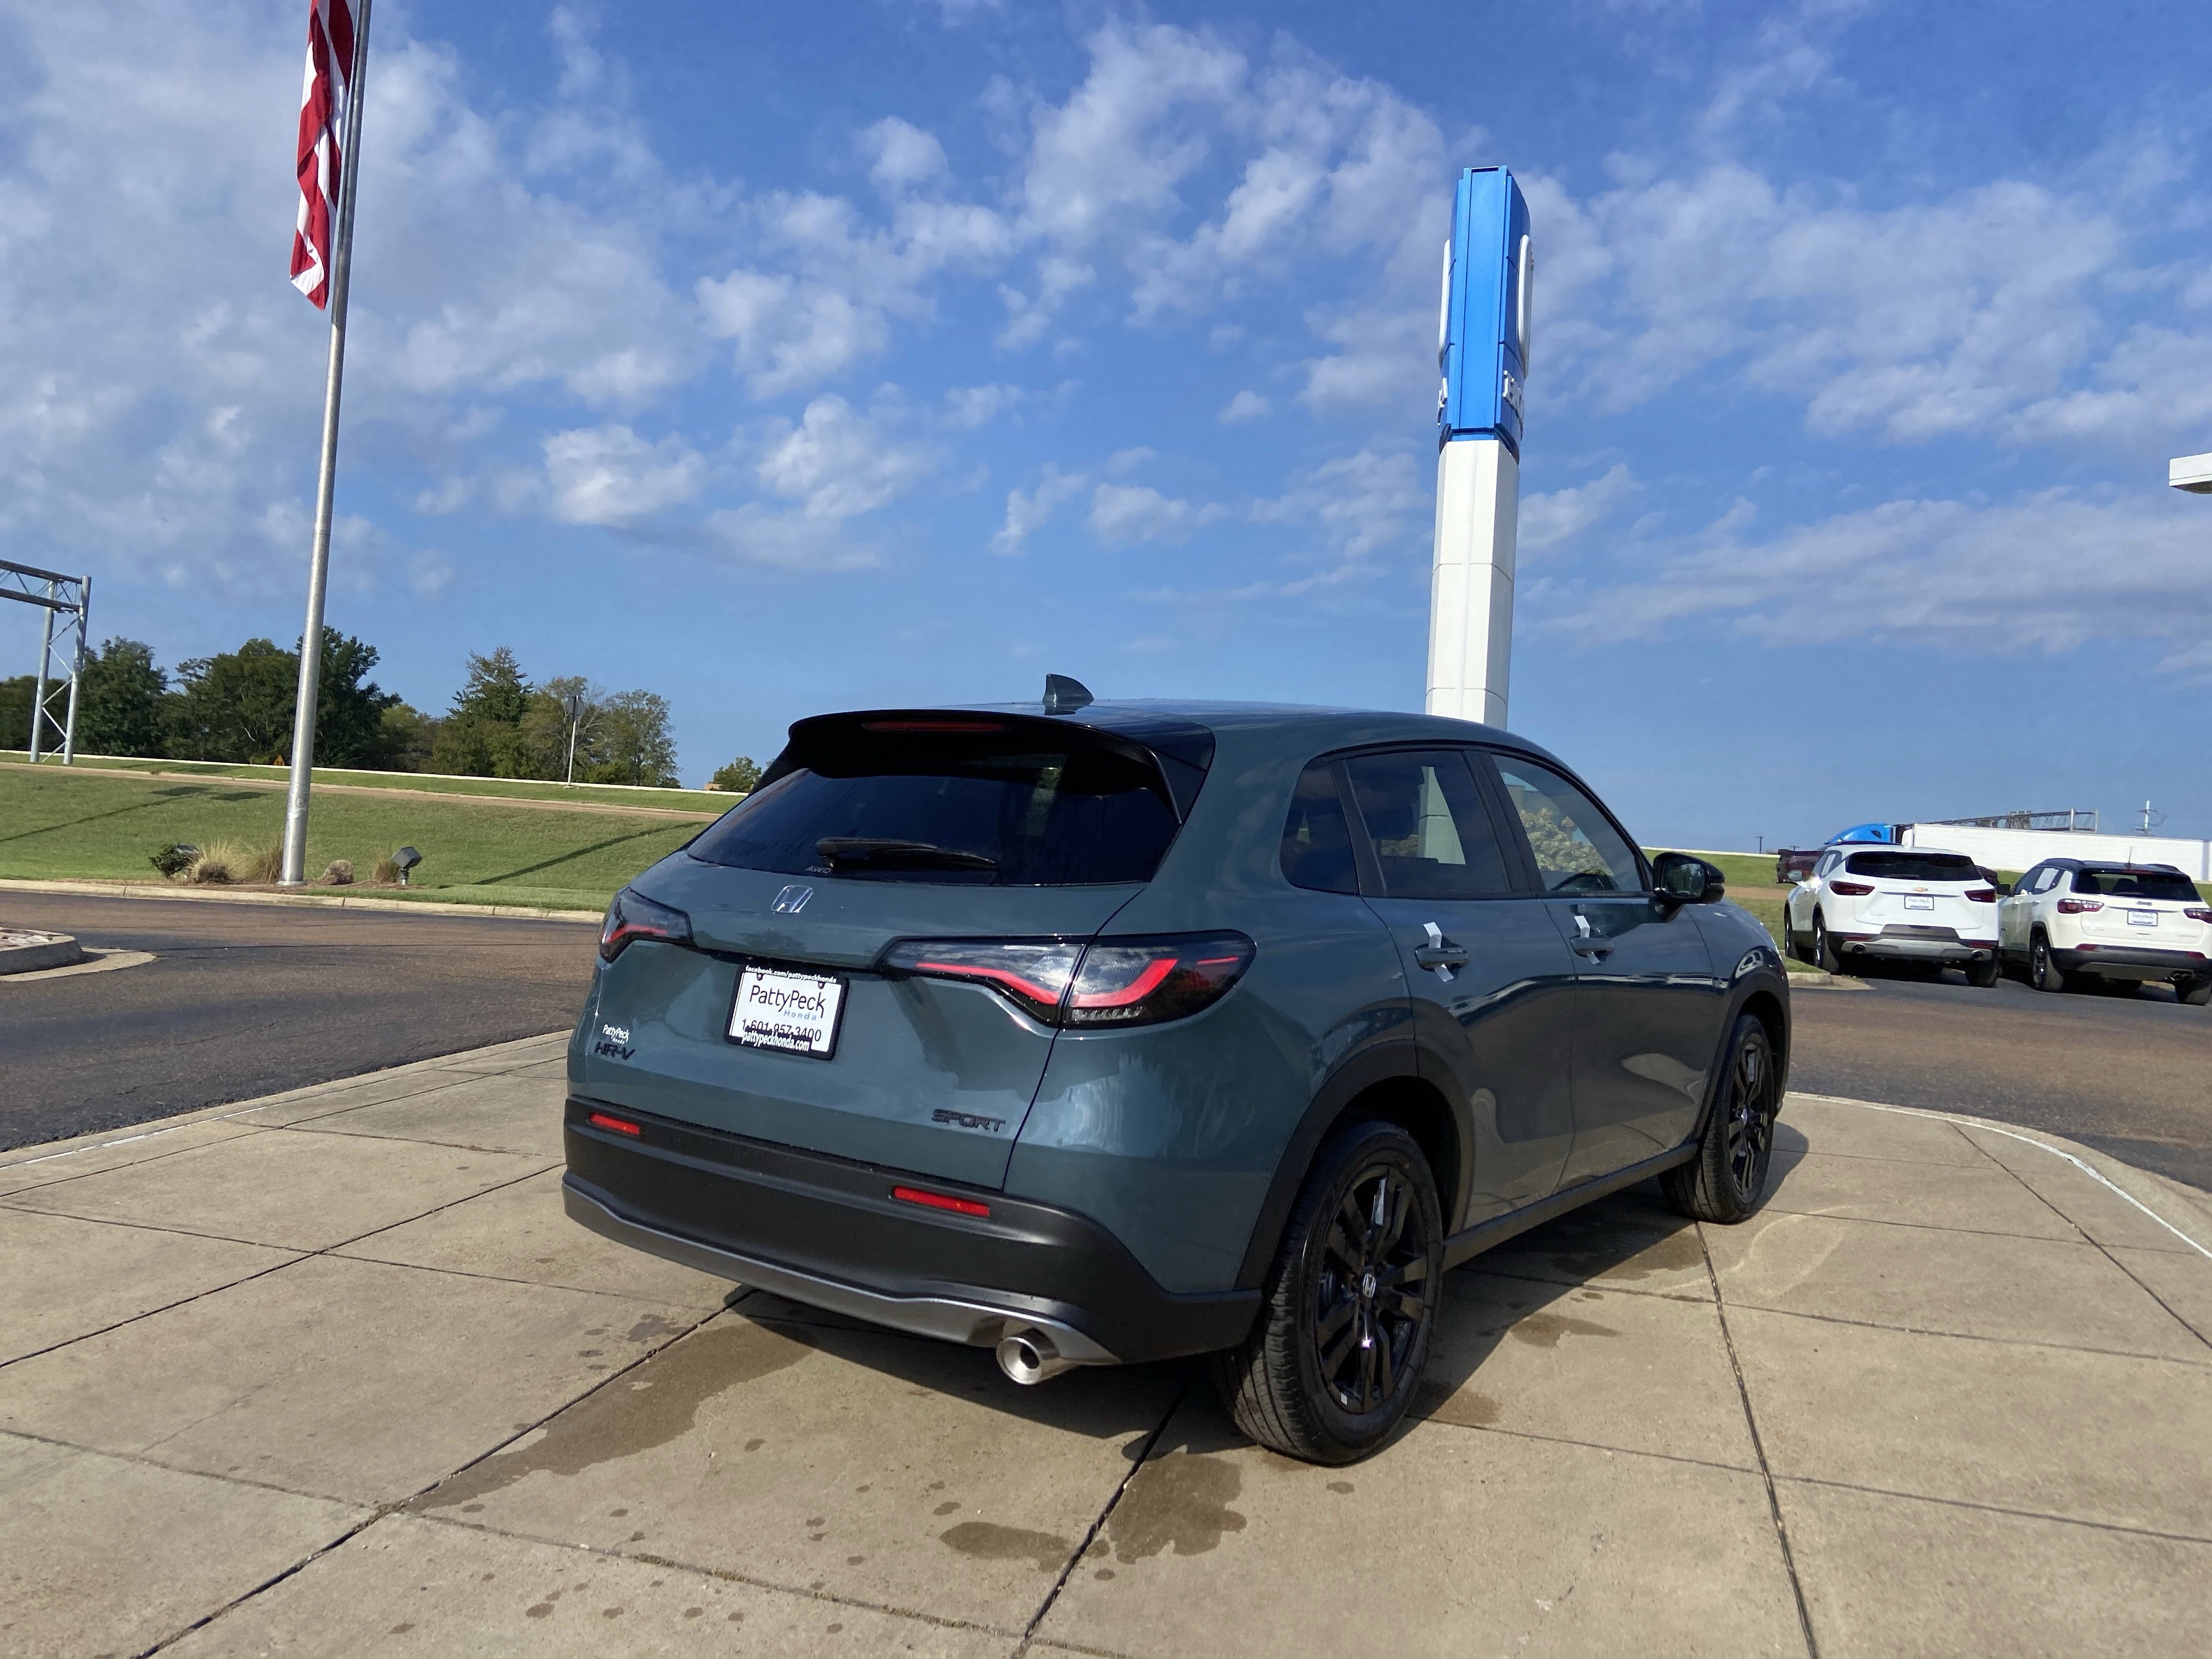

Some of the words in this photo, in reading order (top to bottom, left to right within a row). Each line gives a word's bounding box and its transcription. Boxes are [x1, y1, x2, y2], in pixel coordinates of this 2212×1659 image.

[804, 865, 832, 874] AWD
[746, 964, 837, 984] facebook.com/pattypeckhonda
[749, 985, 827, 1018] PattyPeck
[784, 1009, 817, 1021] Honda
[602, 1024, 630, 1043] PattyPeck
[741, 1030, 810, 1052] pattypeckhonda.com
[594, 1041, 636, 1060] HR-V
[932, 1108, 1007, 1132] SPORT
